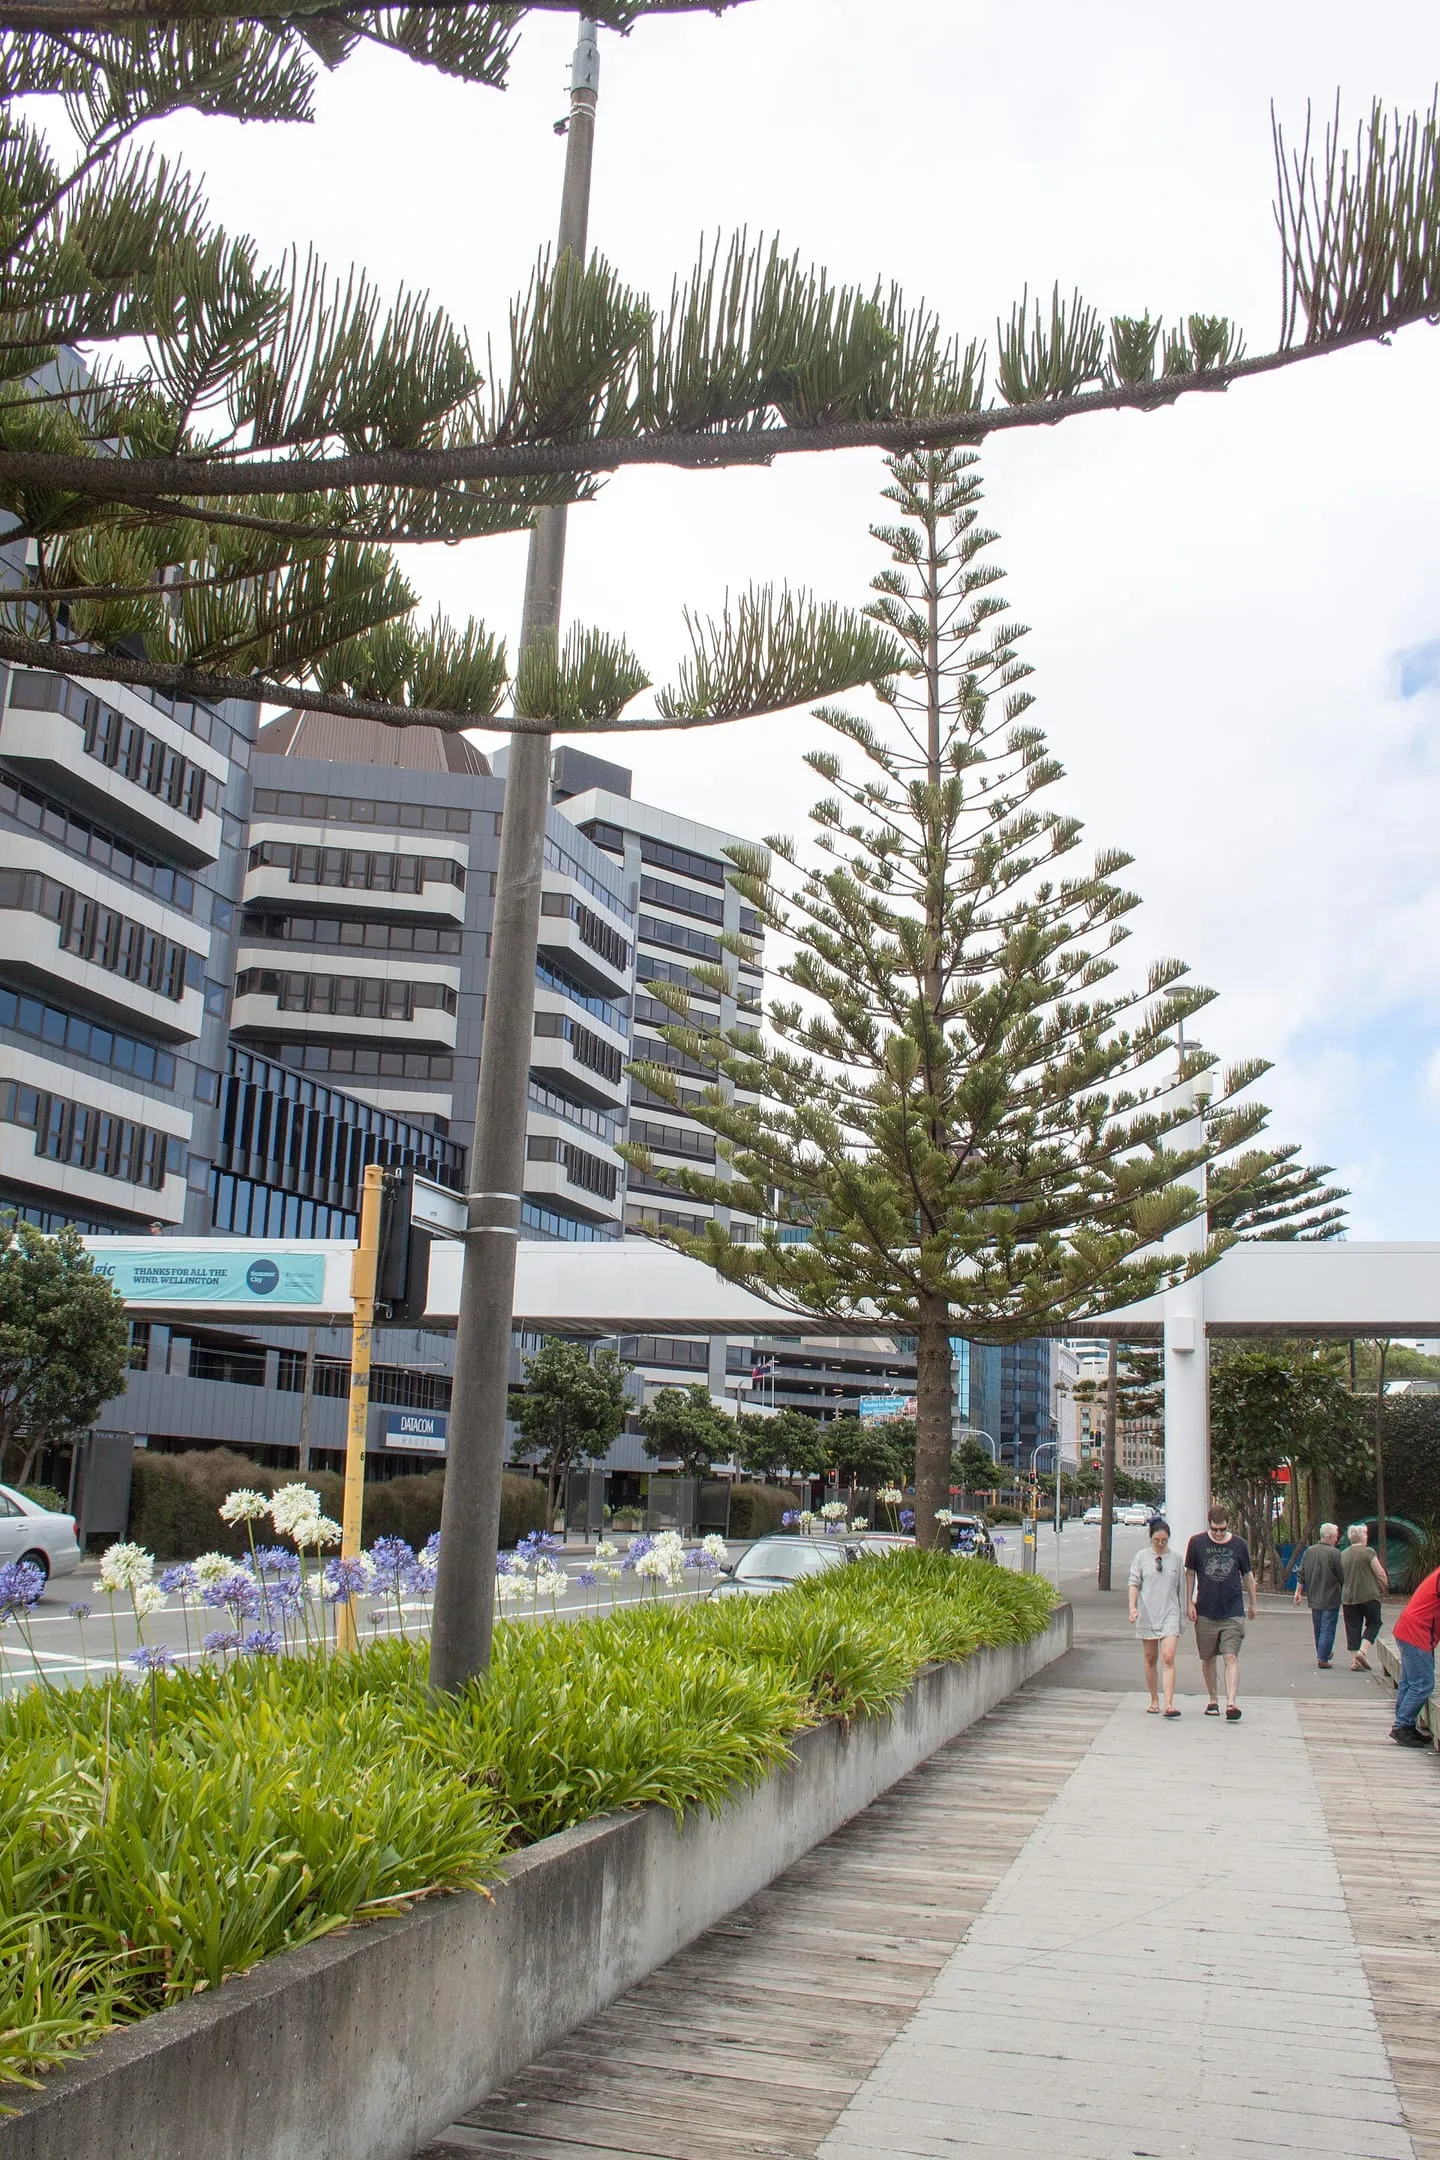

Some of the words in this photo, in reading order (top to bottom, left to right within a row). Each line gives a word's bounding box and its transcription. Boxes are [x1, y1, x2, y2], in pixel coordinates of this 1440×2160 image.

[133, 1267, 170, 1276] THANKS
[171, 1268, 189, 1276] FOR
[190, 1268, 207, 1277] ALL
[208, 1269, 228, 1277] THE
[133, 1276, 160, 1284] WIND,
[160, 1276, 219, 1285] WELLINGTON
[250, 1276, 263, 1284] City
[400, 1416, 434, 1434] DATACOM
